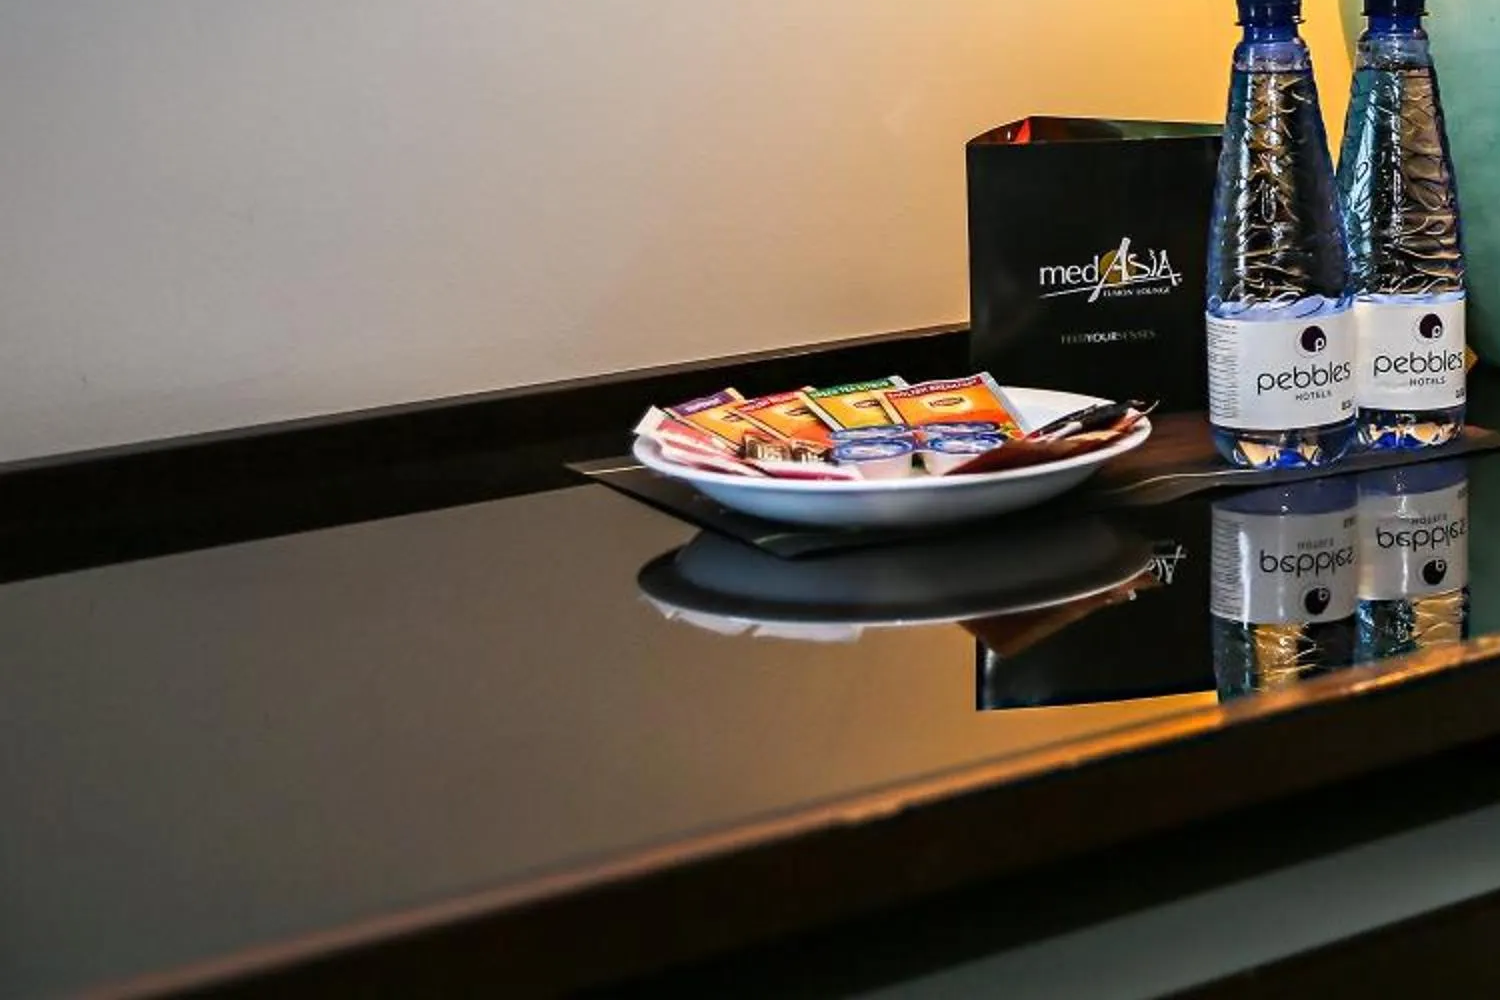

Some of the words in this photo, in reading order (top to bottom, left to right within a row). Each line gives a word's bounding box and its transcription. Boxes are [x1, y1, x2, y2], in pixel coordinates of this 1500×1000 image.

[1373, 349, 1463, 377] pebbles
[1257, 361, 1351, 395] pebbles
[1409, 376, 1446, 387] HOTELS
[1295, 390, 1333, 401] HOTELS
